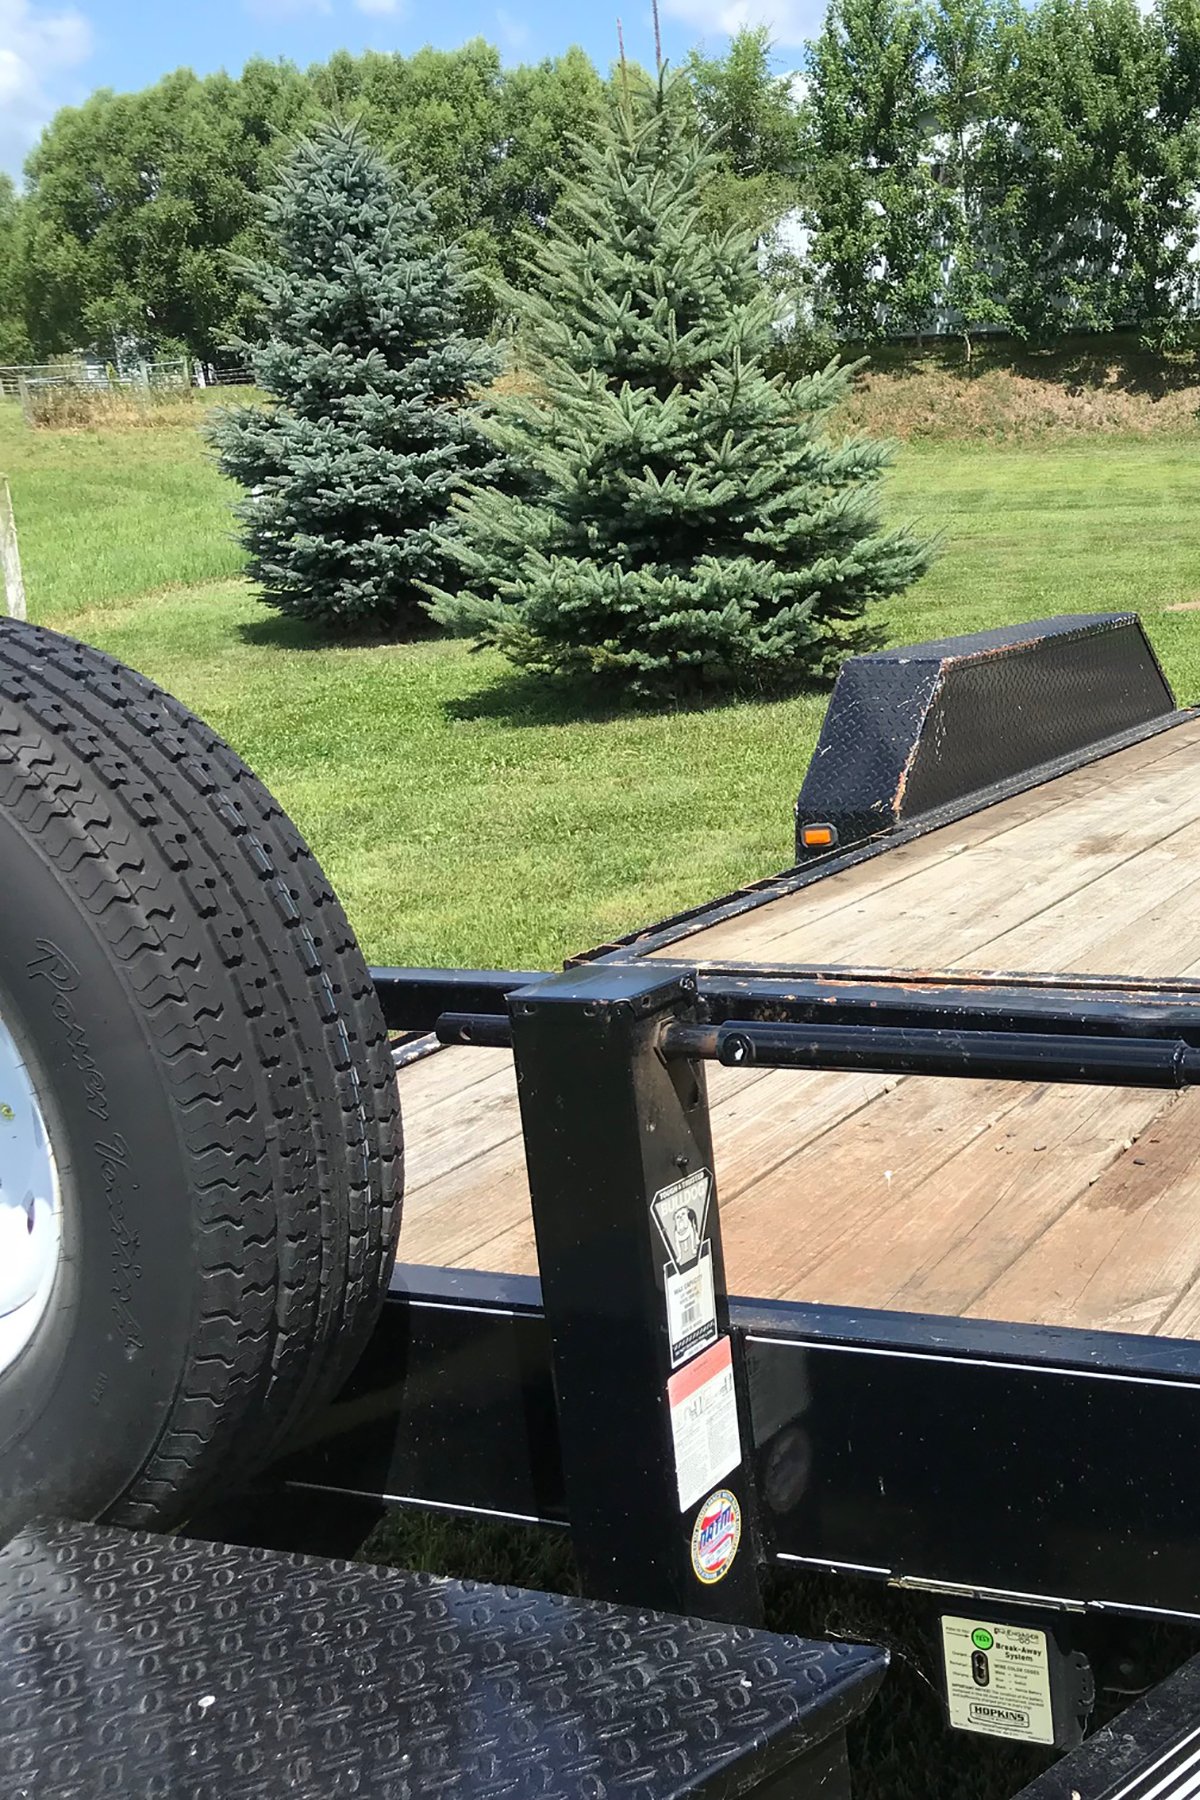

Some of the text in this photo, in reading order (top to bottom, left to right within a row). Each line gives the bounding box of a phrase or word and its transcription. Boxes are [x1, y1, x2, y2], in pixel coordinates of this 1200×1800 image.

[660, 1182, 706, 1217] BULLDOG
[995, 1642, 1042, 1657] Break-Away
[1005, 1652, 1034, 1662] System
[974, 1706, 1025, 1722] HOPKINS
